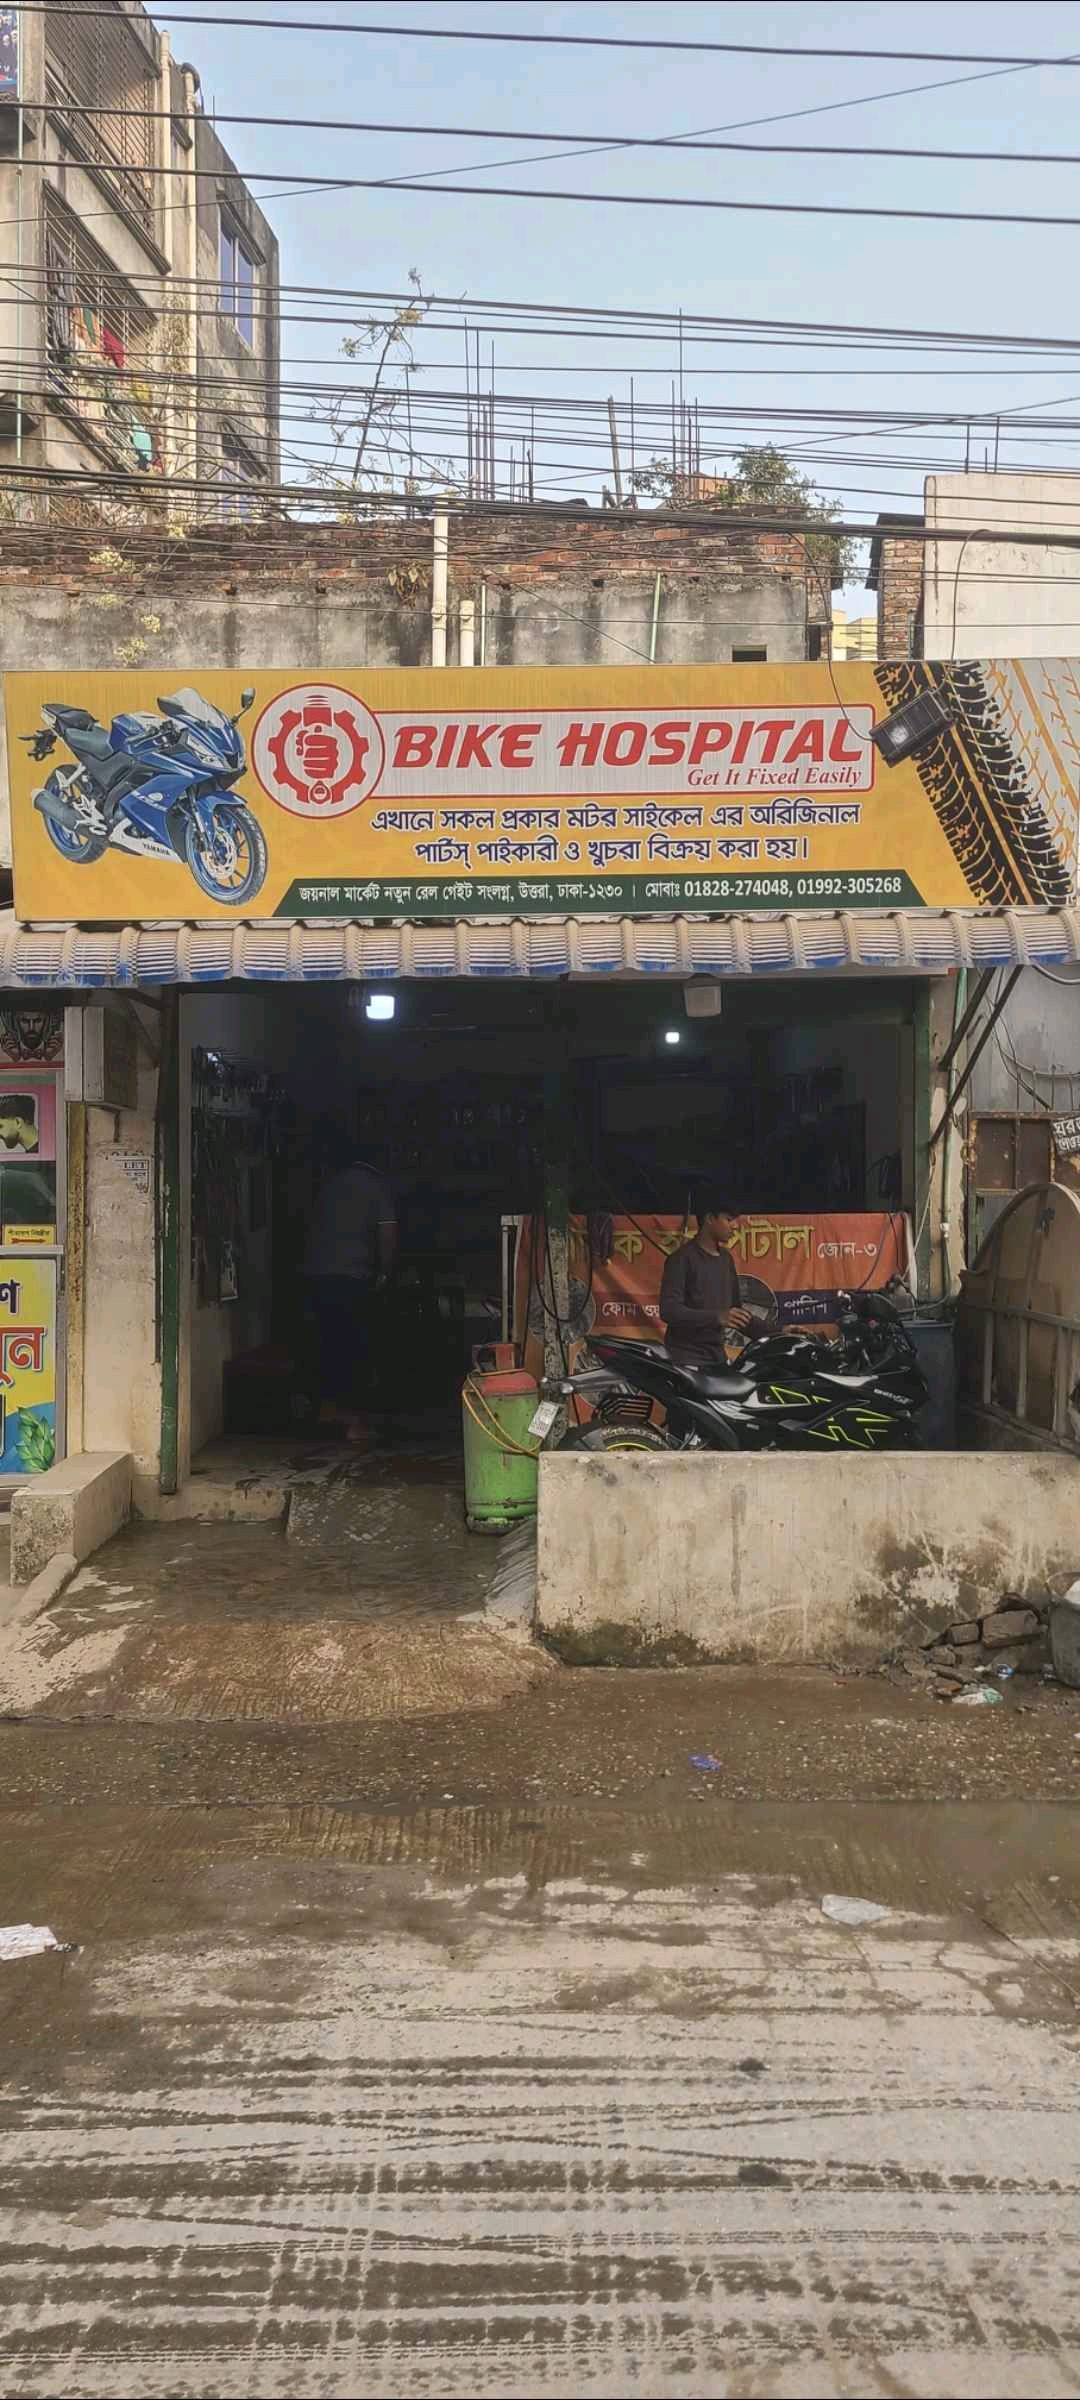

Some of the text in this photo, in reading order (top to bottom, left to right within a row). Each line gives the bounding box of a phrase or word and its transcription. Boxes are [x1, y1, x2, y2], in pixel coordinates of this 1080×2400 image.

[392, 720, 863, 768] BIKE HOSPITAL
[688, 767, 861, 787] Get It Fixed Easily
[371, 798, 860, 830] এখানে সকল প্রকার মটর সাইকেল এর অরিজিনাল
[415, 838, 472, 868] পার্টস্
[477, 835, 559, 863] পাইকারী
[564, 845, 580, 860] ও
[588, 841, 641, 865] খুচরা
[648, 833, 711, 860] বিক্রয়
[718, 839, 758, 858] করা
[299, 886, 341, 902] জয়নাল
[344, 881, 381, 902] মার্কেট
[383, 886, 412, 904] নতুন
[415, 885, 439, 901] রেল
[443, 881, 473, 901] গেইট
[518, 881, 553, 902] উত্তরা,
[556, 882, 623, 900] ঢাকা-১২৩০
[685, 878, 793, 897] 01828-274048,
[797, 877, 901, 895] 01992-305268
